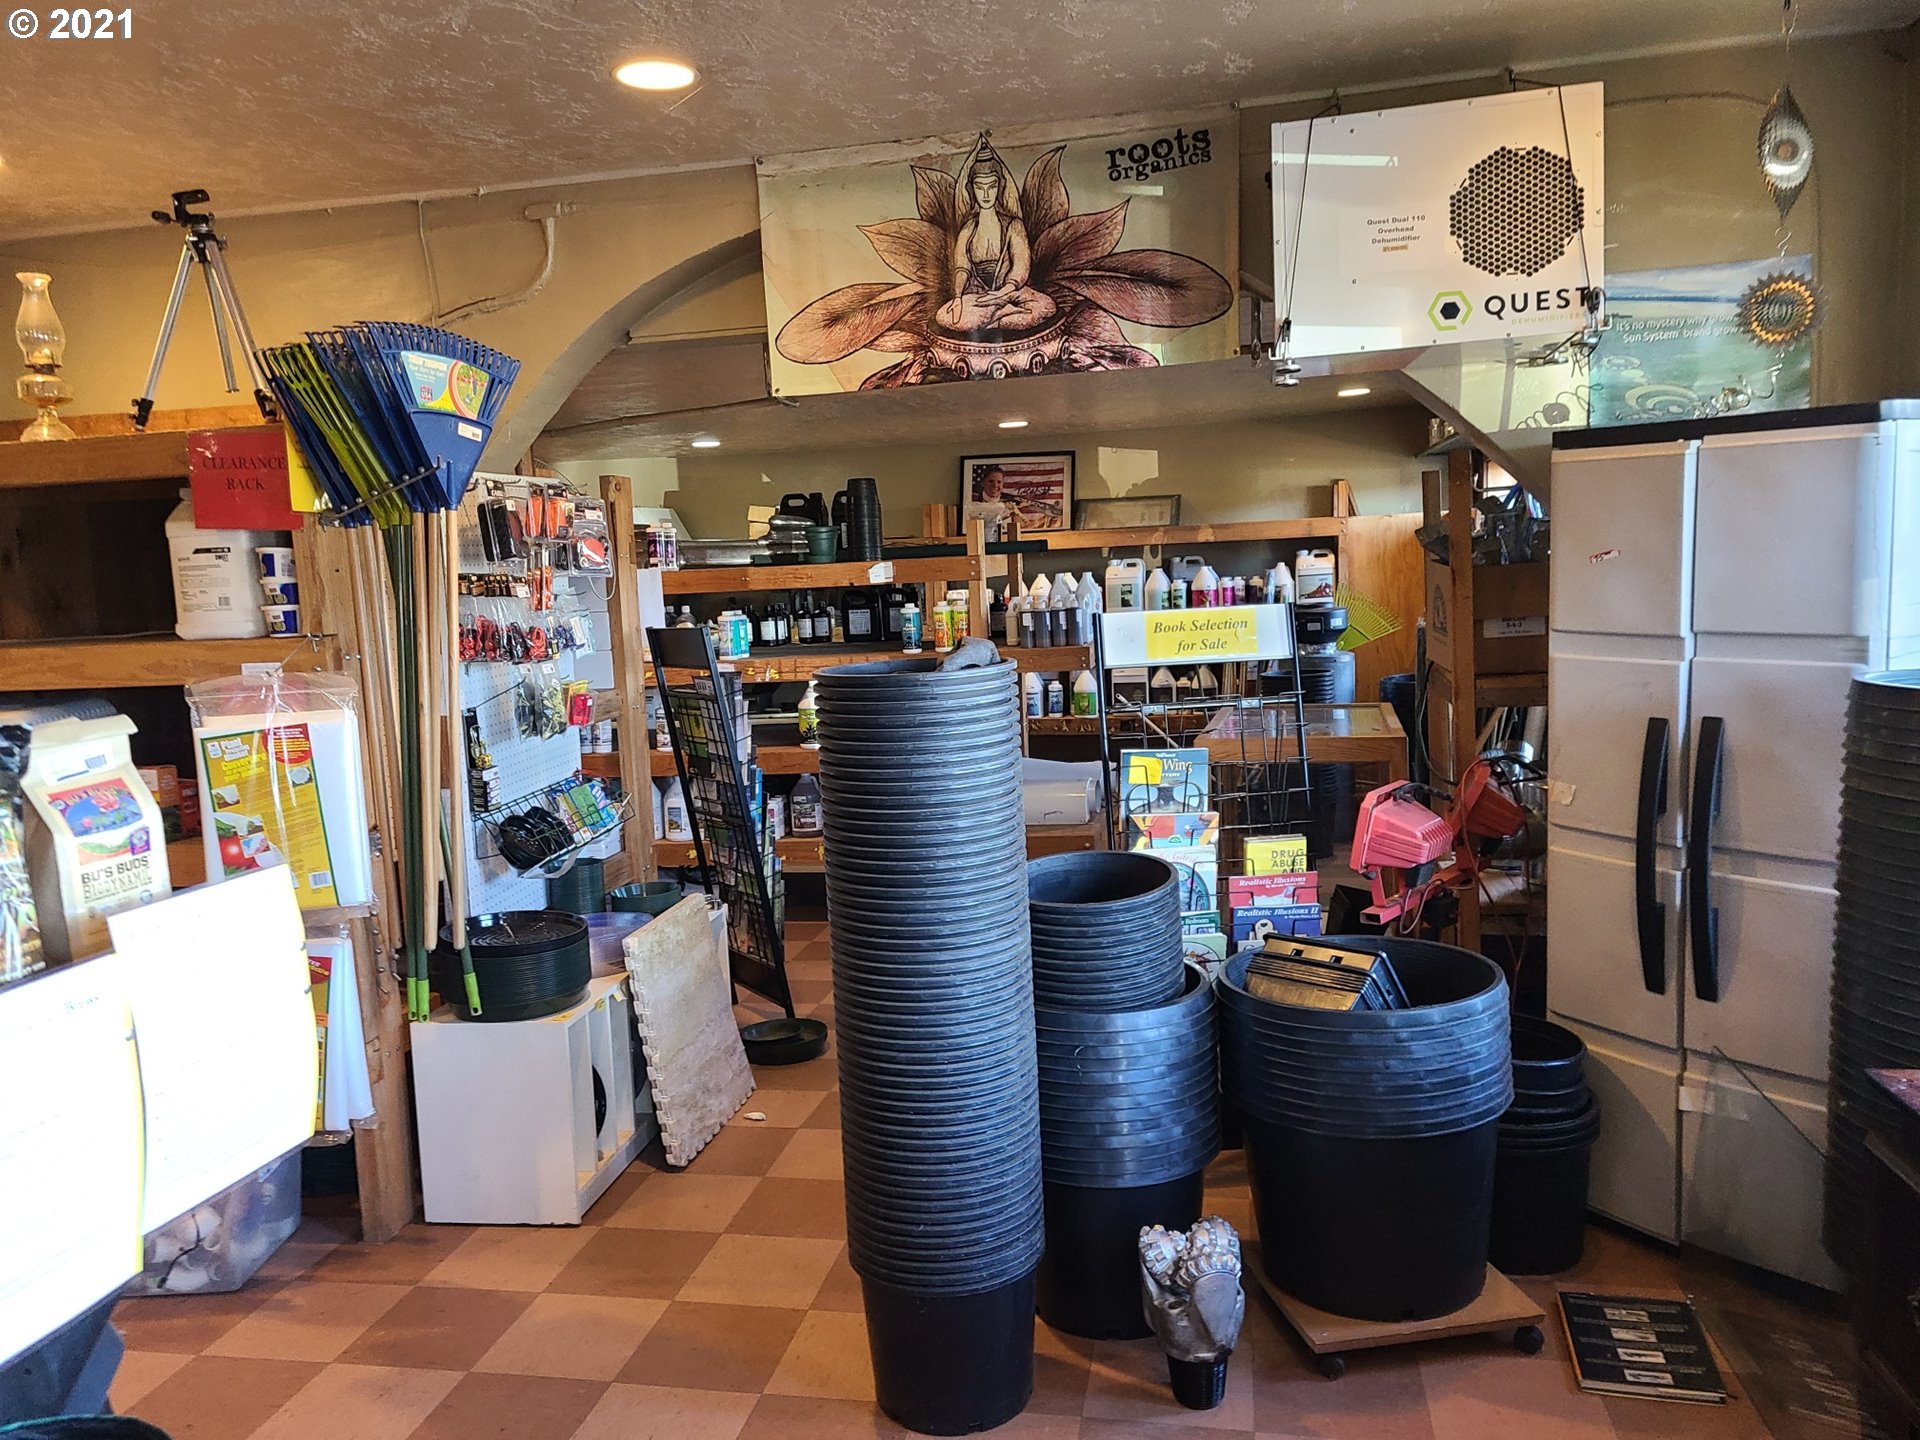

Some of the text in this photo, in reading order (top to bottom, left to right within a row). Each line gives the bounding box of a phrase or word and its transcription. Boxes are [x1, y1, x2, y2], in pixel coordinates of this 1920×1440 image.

[1105, 127, 1212, 170] roots
[1108, 149, 1212, 182] organics
[1366, 214, 1426, 226] Quest Dual 110
[1377, 225, 1415, 234] Overhead
[1371, 234, 1421, 244] Dehumidifier
[1484, 286, 1590, 321] QUEST
[1632, 320, 1645, 330] no
[1646, 316, 1687, 330] mystery
[1622, 332, 1642, 344] Sun
[1643, 328, 1680, 343] System
[202, 456, 288, 471] CLEARANCE
[226, 478, 265, 491] RACK
[1153, 617, 1248, 634] Book Selection
[1175, 637, 1228, 655] for Sale
[1162, 758, 1193, 774] Wing
[1271, 848, 1304, 859] DRUG
[116, 855, 149, 875] BUDS
[1271, 857, 1304, 868] ABUSE
[1239, 877, 1273, 887] Realistic
[1273, 875, 1307, 885] Illusions
[1236, 906, 1320, 917] Realistic Illusions II
